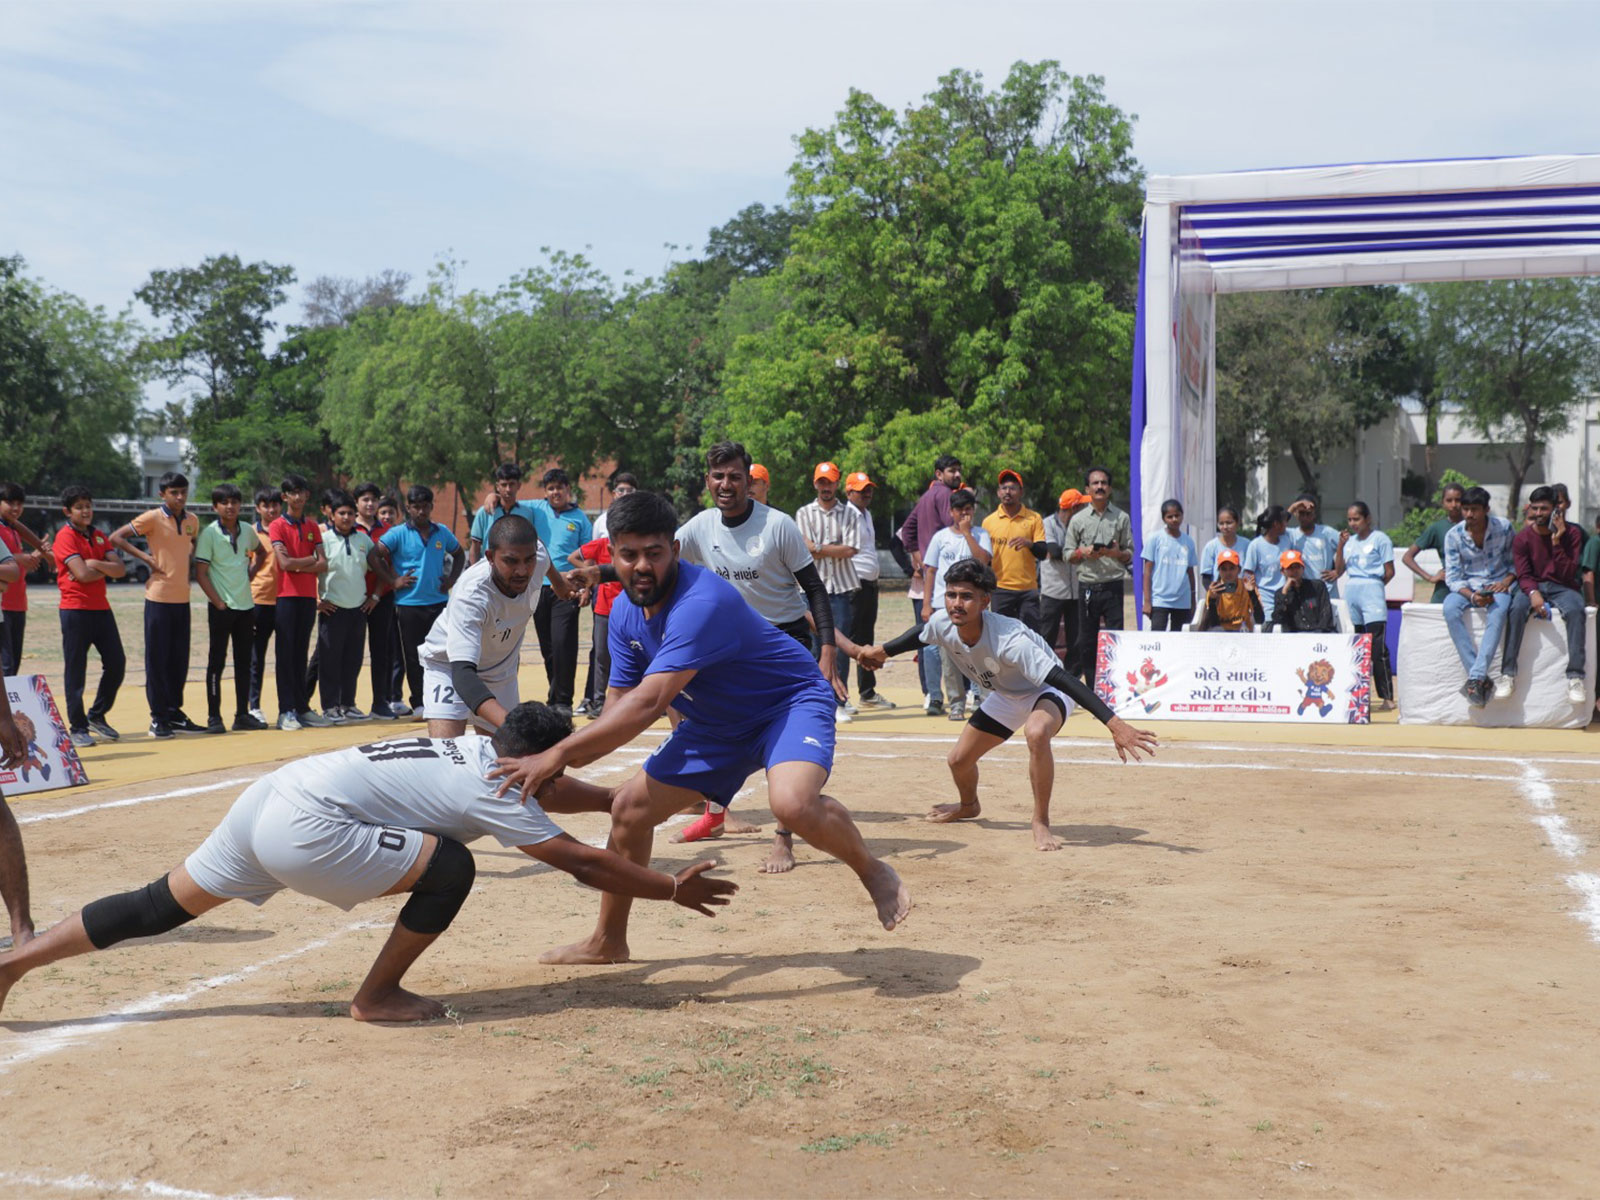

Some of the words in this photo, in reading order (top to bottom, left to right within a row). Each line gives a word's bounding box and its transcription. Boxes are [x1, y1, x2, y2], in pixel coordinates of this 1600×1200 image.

[733, 567, 760, 580] સાણંદ
[1312, 643, 1329, 653] વીર
[1194, 667, 1220, 681] ખેલે
[1226, 668, 1267, 682] સાણંદ
[433, 684, 455, 704] 12
[1240, 686, 1271, 701] લીગ
